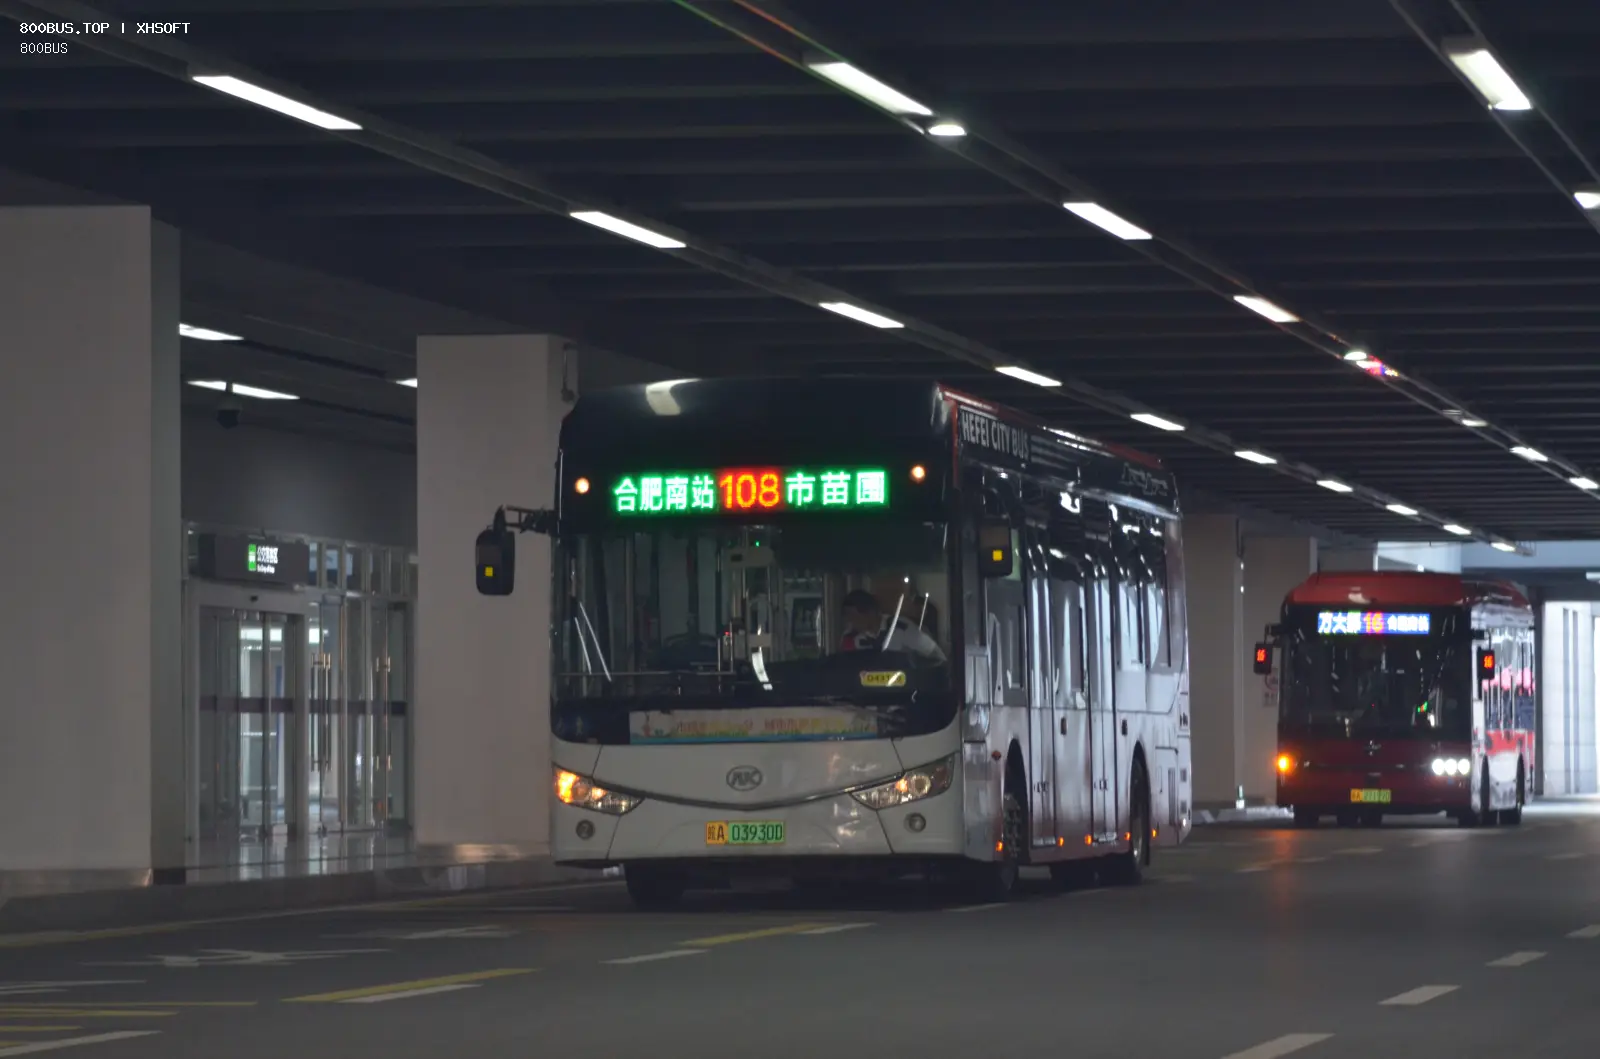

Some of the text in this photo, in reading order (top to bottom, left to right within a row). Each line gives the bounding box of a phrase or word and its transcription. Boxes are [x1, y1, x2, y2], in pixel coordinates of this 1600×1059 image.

[961, 410, 1029, 460] HEFEI CITY BUS
[614, 475, 714, 512] 合肥南站
[719, 473, 780, 509] 108
[1363, 610, 1384, 634] 16
